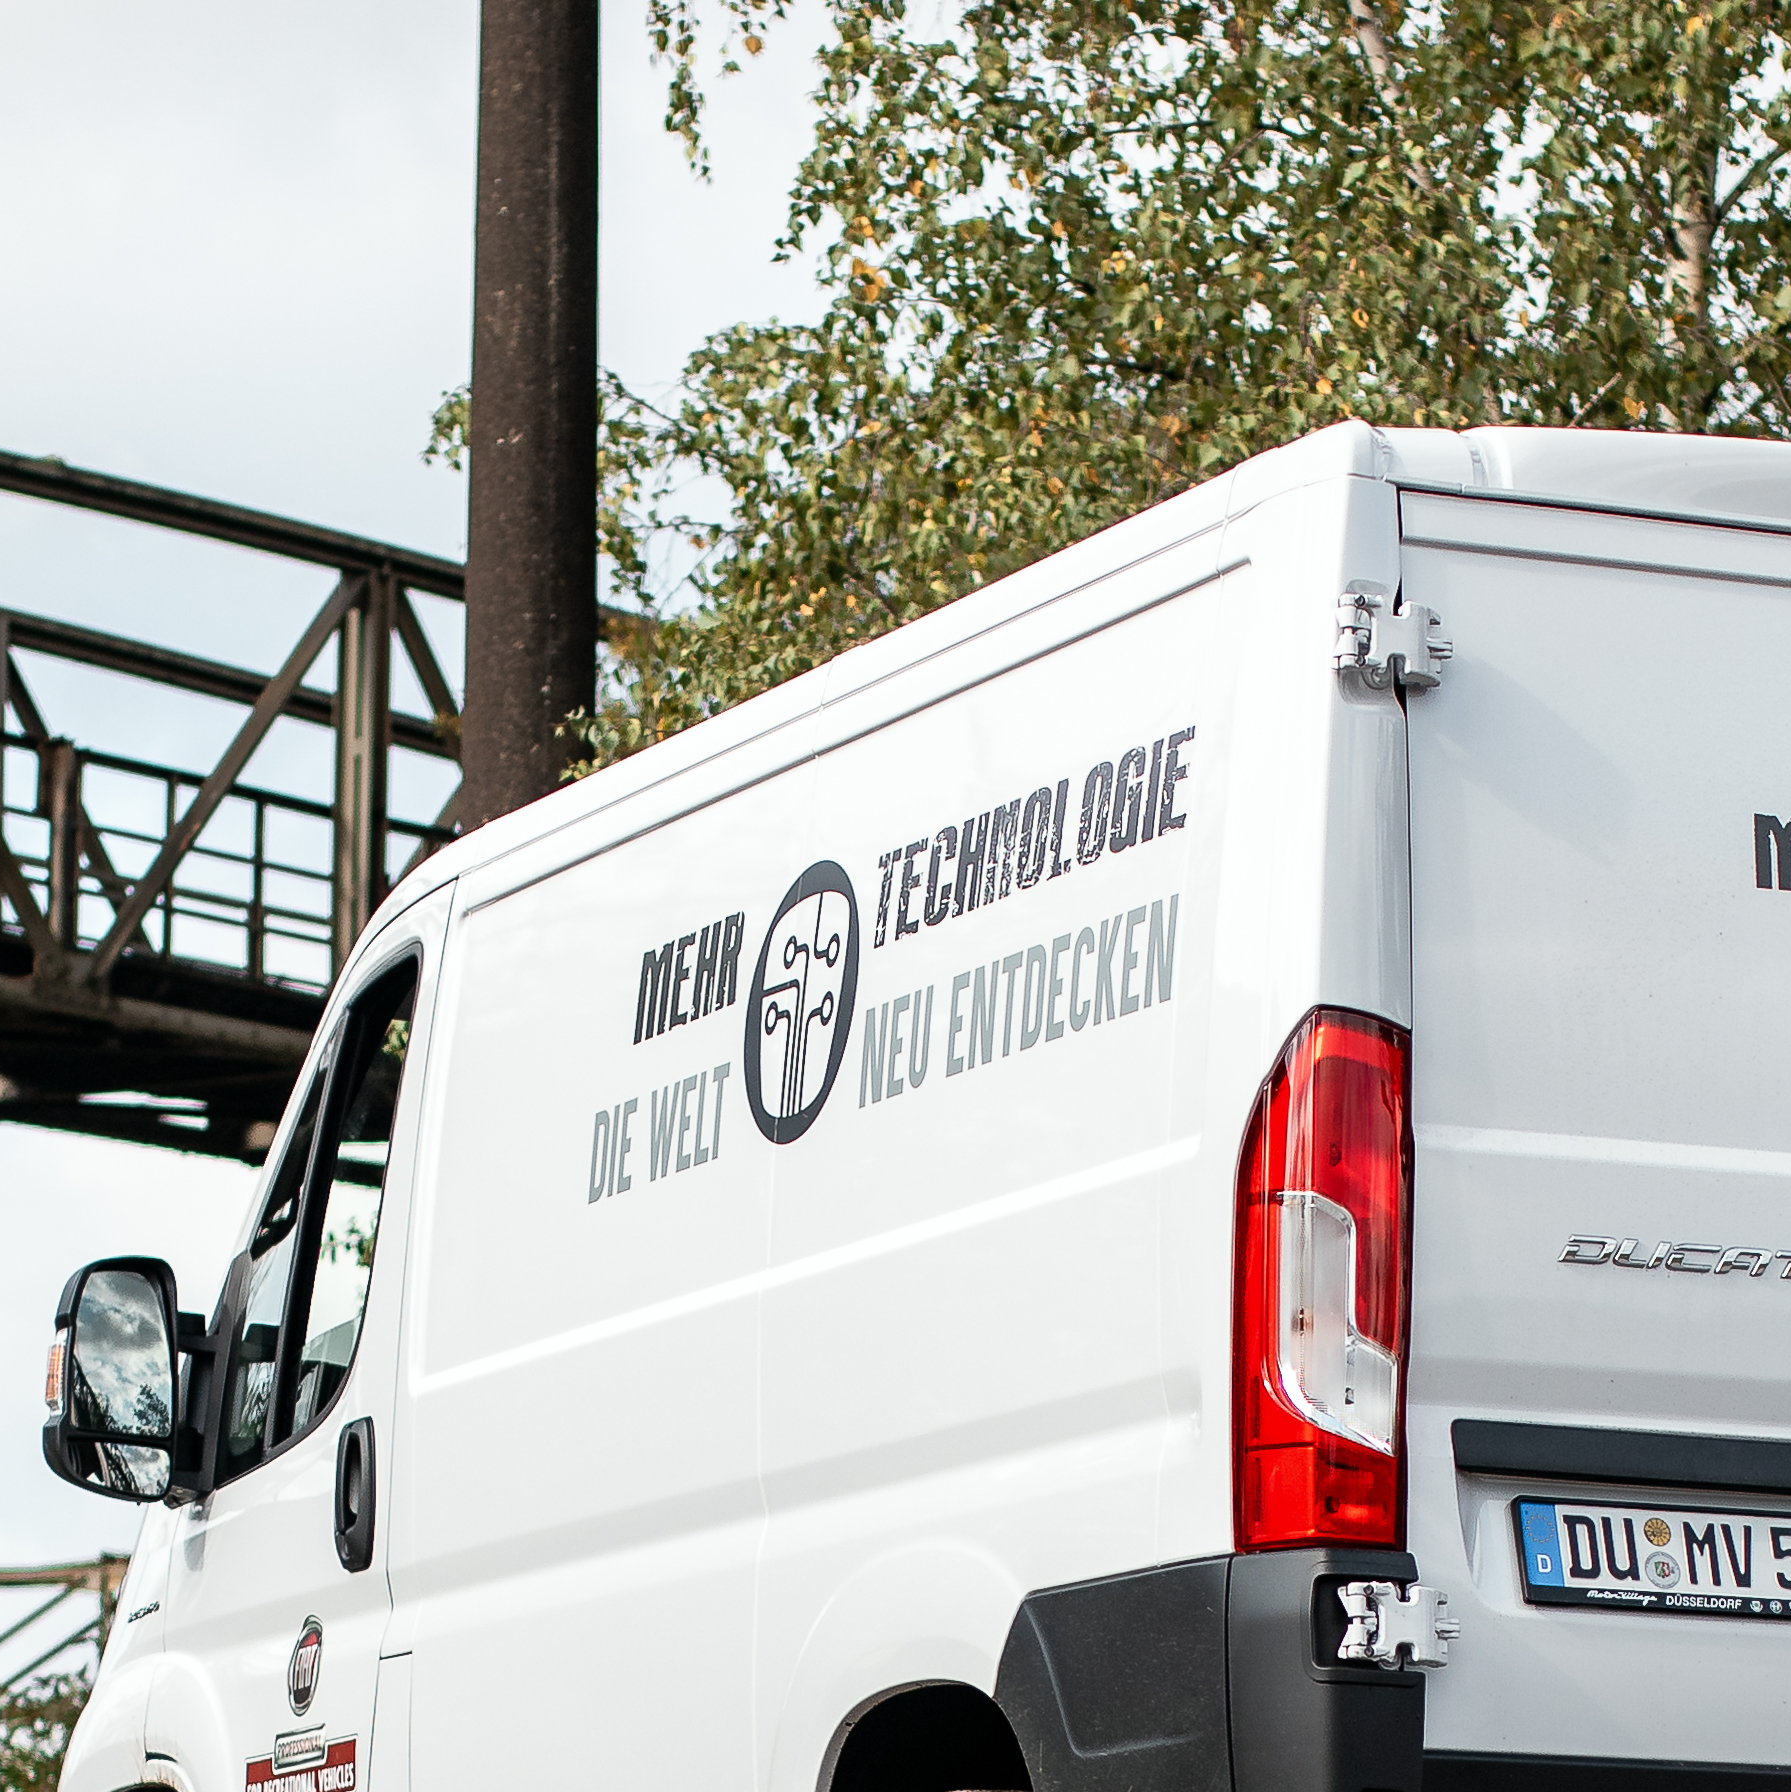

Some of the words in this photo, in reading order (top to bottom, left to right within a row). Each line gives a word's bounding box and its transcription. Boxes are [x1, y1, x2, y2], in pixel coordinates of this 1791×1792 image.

[633, 911, 746, 1045] MEHR
[873, 725, 1196, 949] TECHNOLOGIE
[588, 1096, 639, 1205] DIE
[650, 1061, 731, 1183] WELT
[859, 984, 936, 1109] NEU
[945, 893, 1179, 1079] ENTDECKEN
[1537, 1554, 1552, 1573] D
[1562, 1514, 1641, 1581] DU
[1682, 1520, 1753, 1588] MV
[1665, 1593, 1743, 1610] DÜSSELDORF
[317, 1762, 354, 1792] VEHICLES
